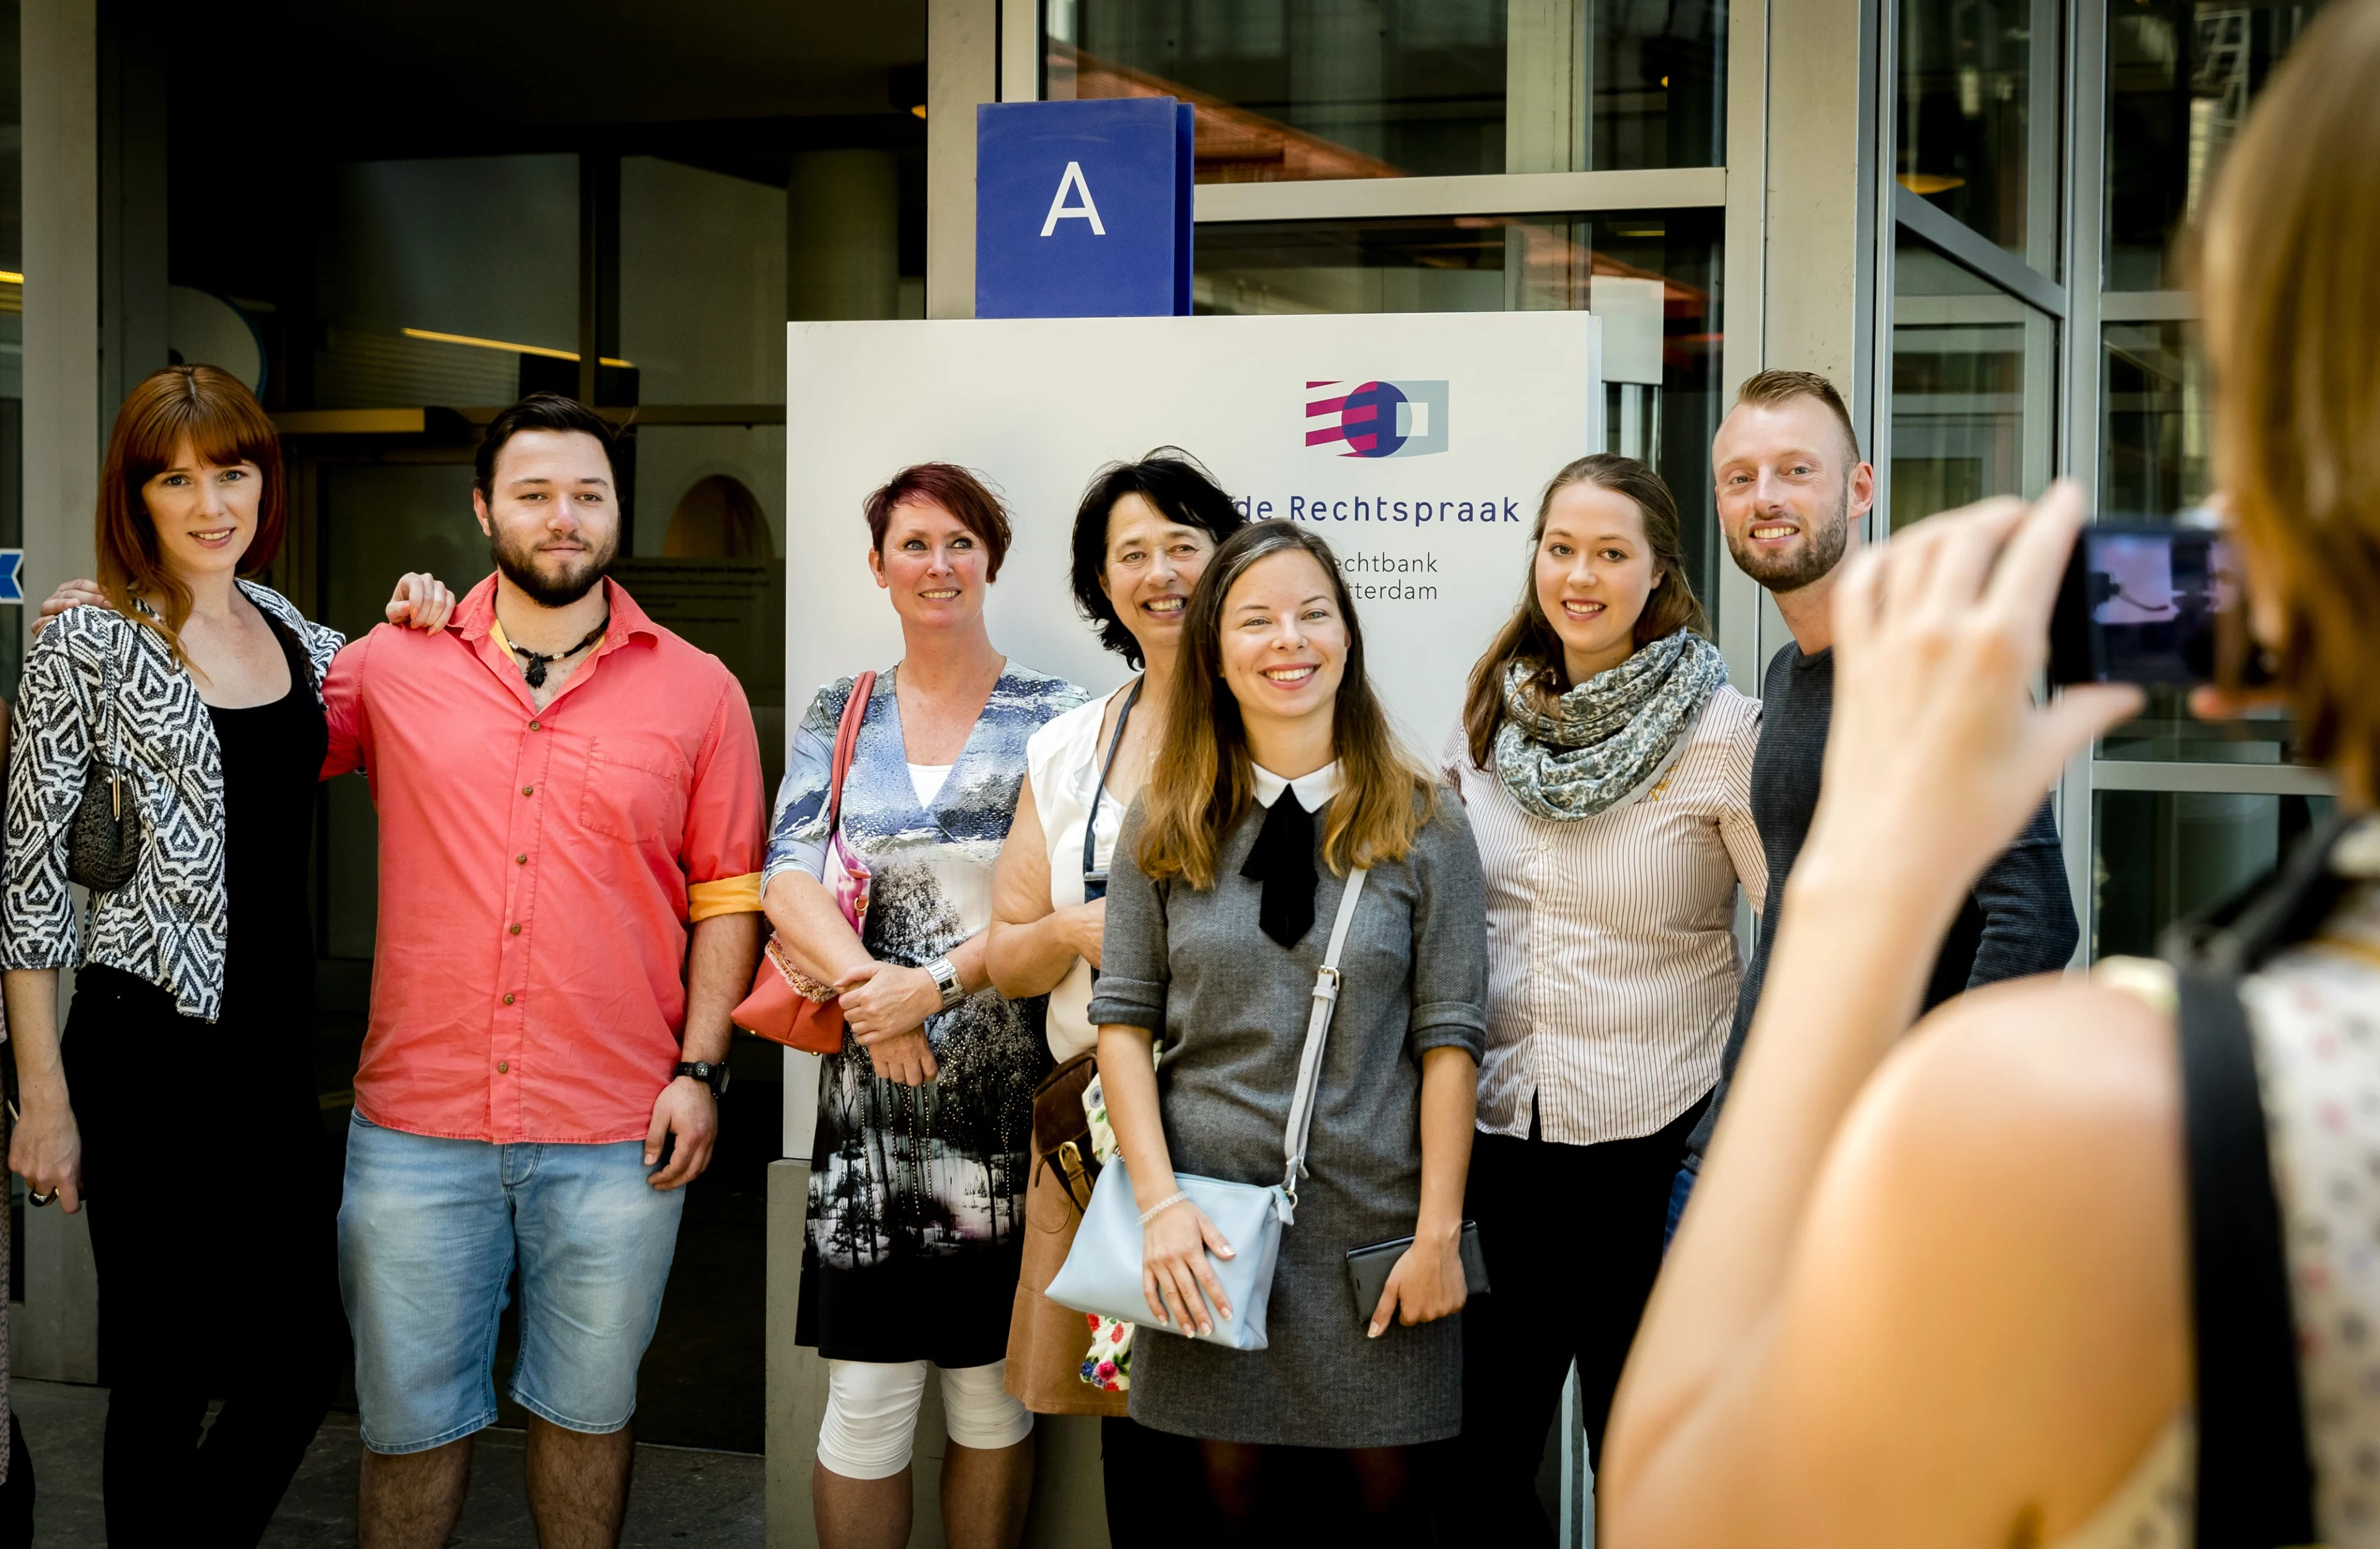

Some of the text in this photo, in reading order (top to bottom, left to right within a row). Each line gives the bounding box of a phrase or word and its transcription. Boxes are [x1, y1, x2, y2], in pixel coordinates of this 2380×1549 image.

[1040, 161, 1106, 236] A
[1235, 496, 1520, 527] de Rechtspraak
[1334, 552, 1437, 572] chtbank
